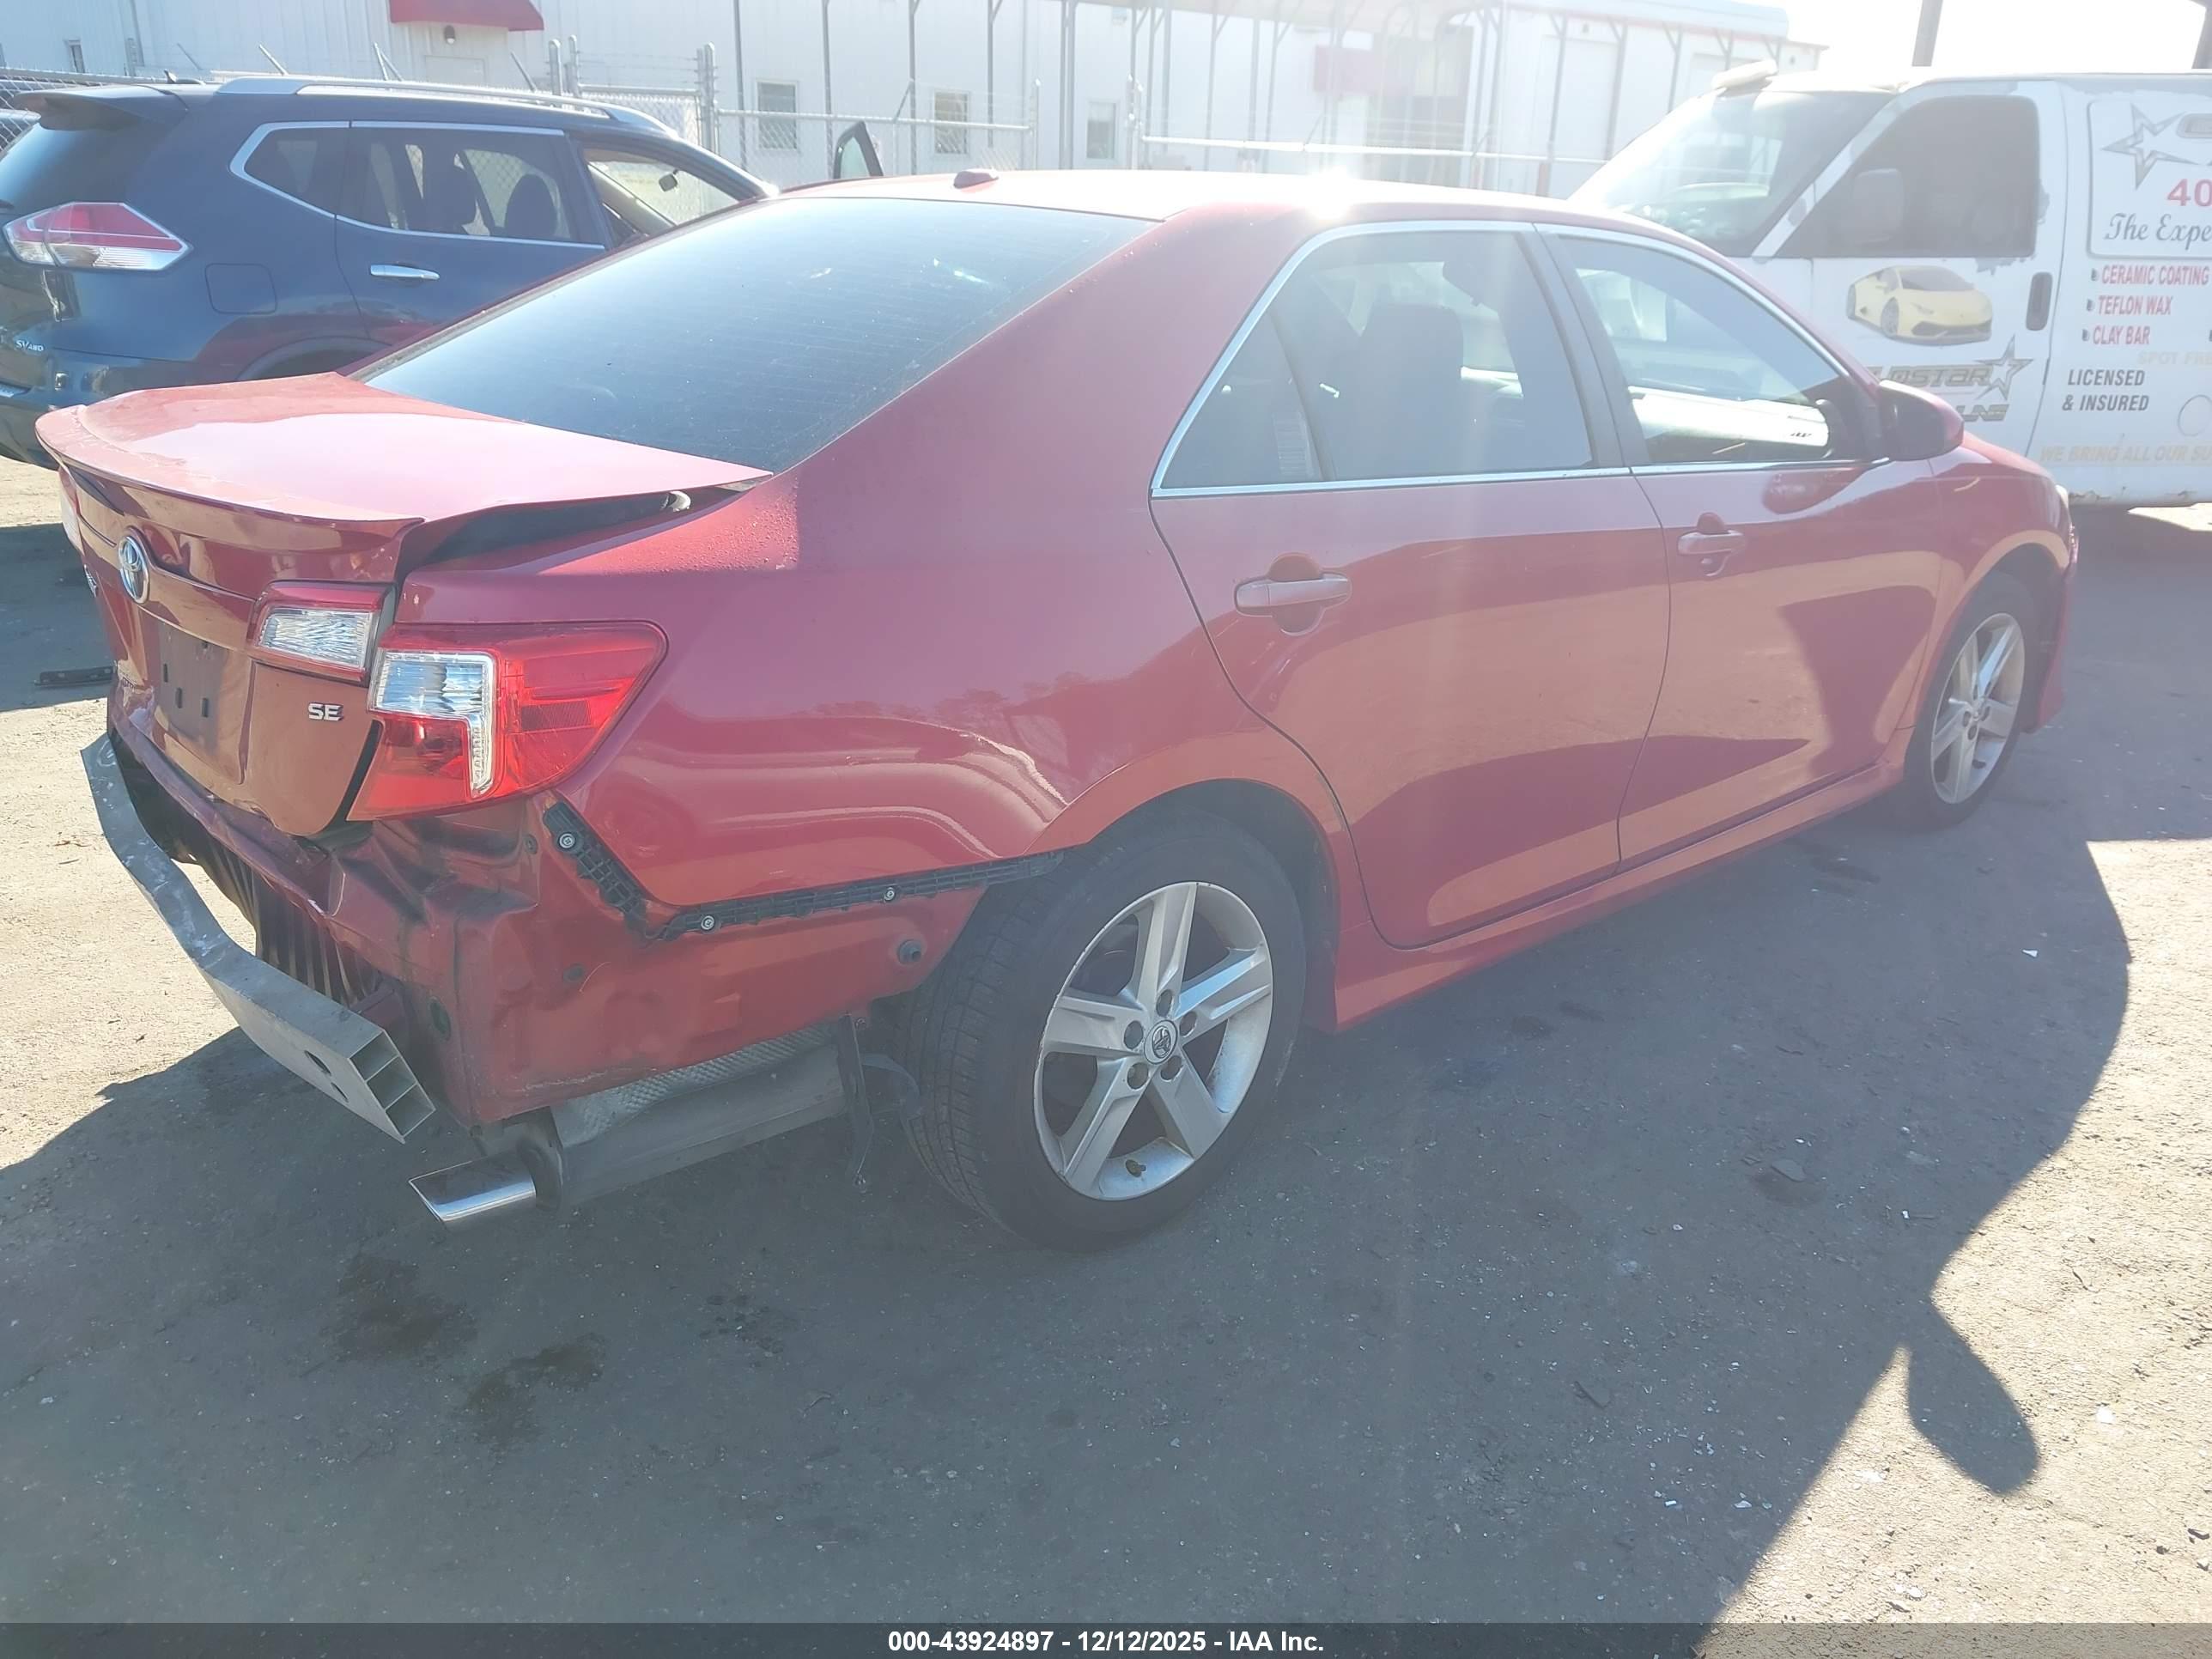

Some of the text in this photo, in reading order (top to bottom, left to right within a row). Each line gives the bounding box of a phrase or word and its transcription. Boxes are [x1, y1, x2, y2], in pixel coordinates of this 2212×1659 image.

[2104, 213, 2212, 251] The Expe
[2102, 264, 2209, 285] CERAMIC COATING
[2099, 295, 2173, 315] TEFLON WAX
[2093, 325, 2151, 344] CLAY BAR
[2137, 351, 2178, 364] SPOT
[2067, 369, 2146, 386] LICENSED
[2062, 394, 2149, 411] & INSURED
[2040, 446, 2065, 461] WE
[2068, 446, 2119, 461] BRING
[2123, 446, 2150, 461] ALL
[2155, 446, 2188, 461] OUR
[308, 702, 343, 721] SE
